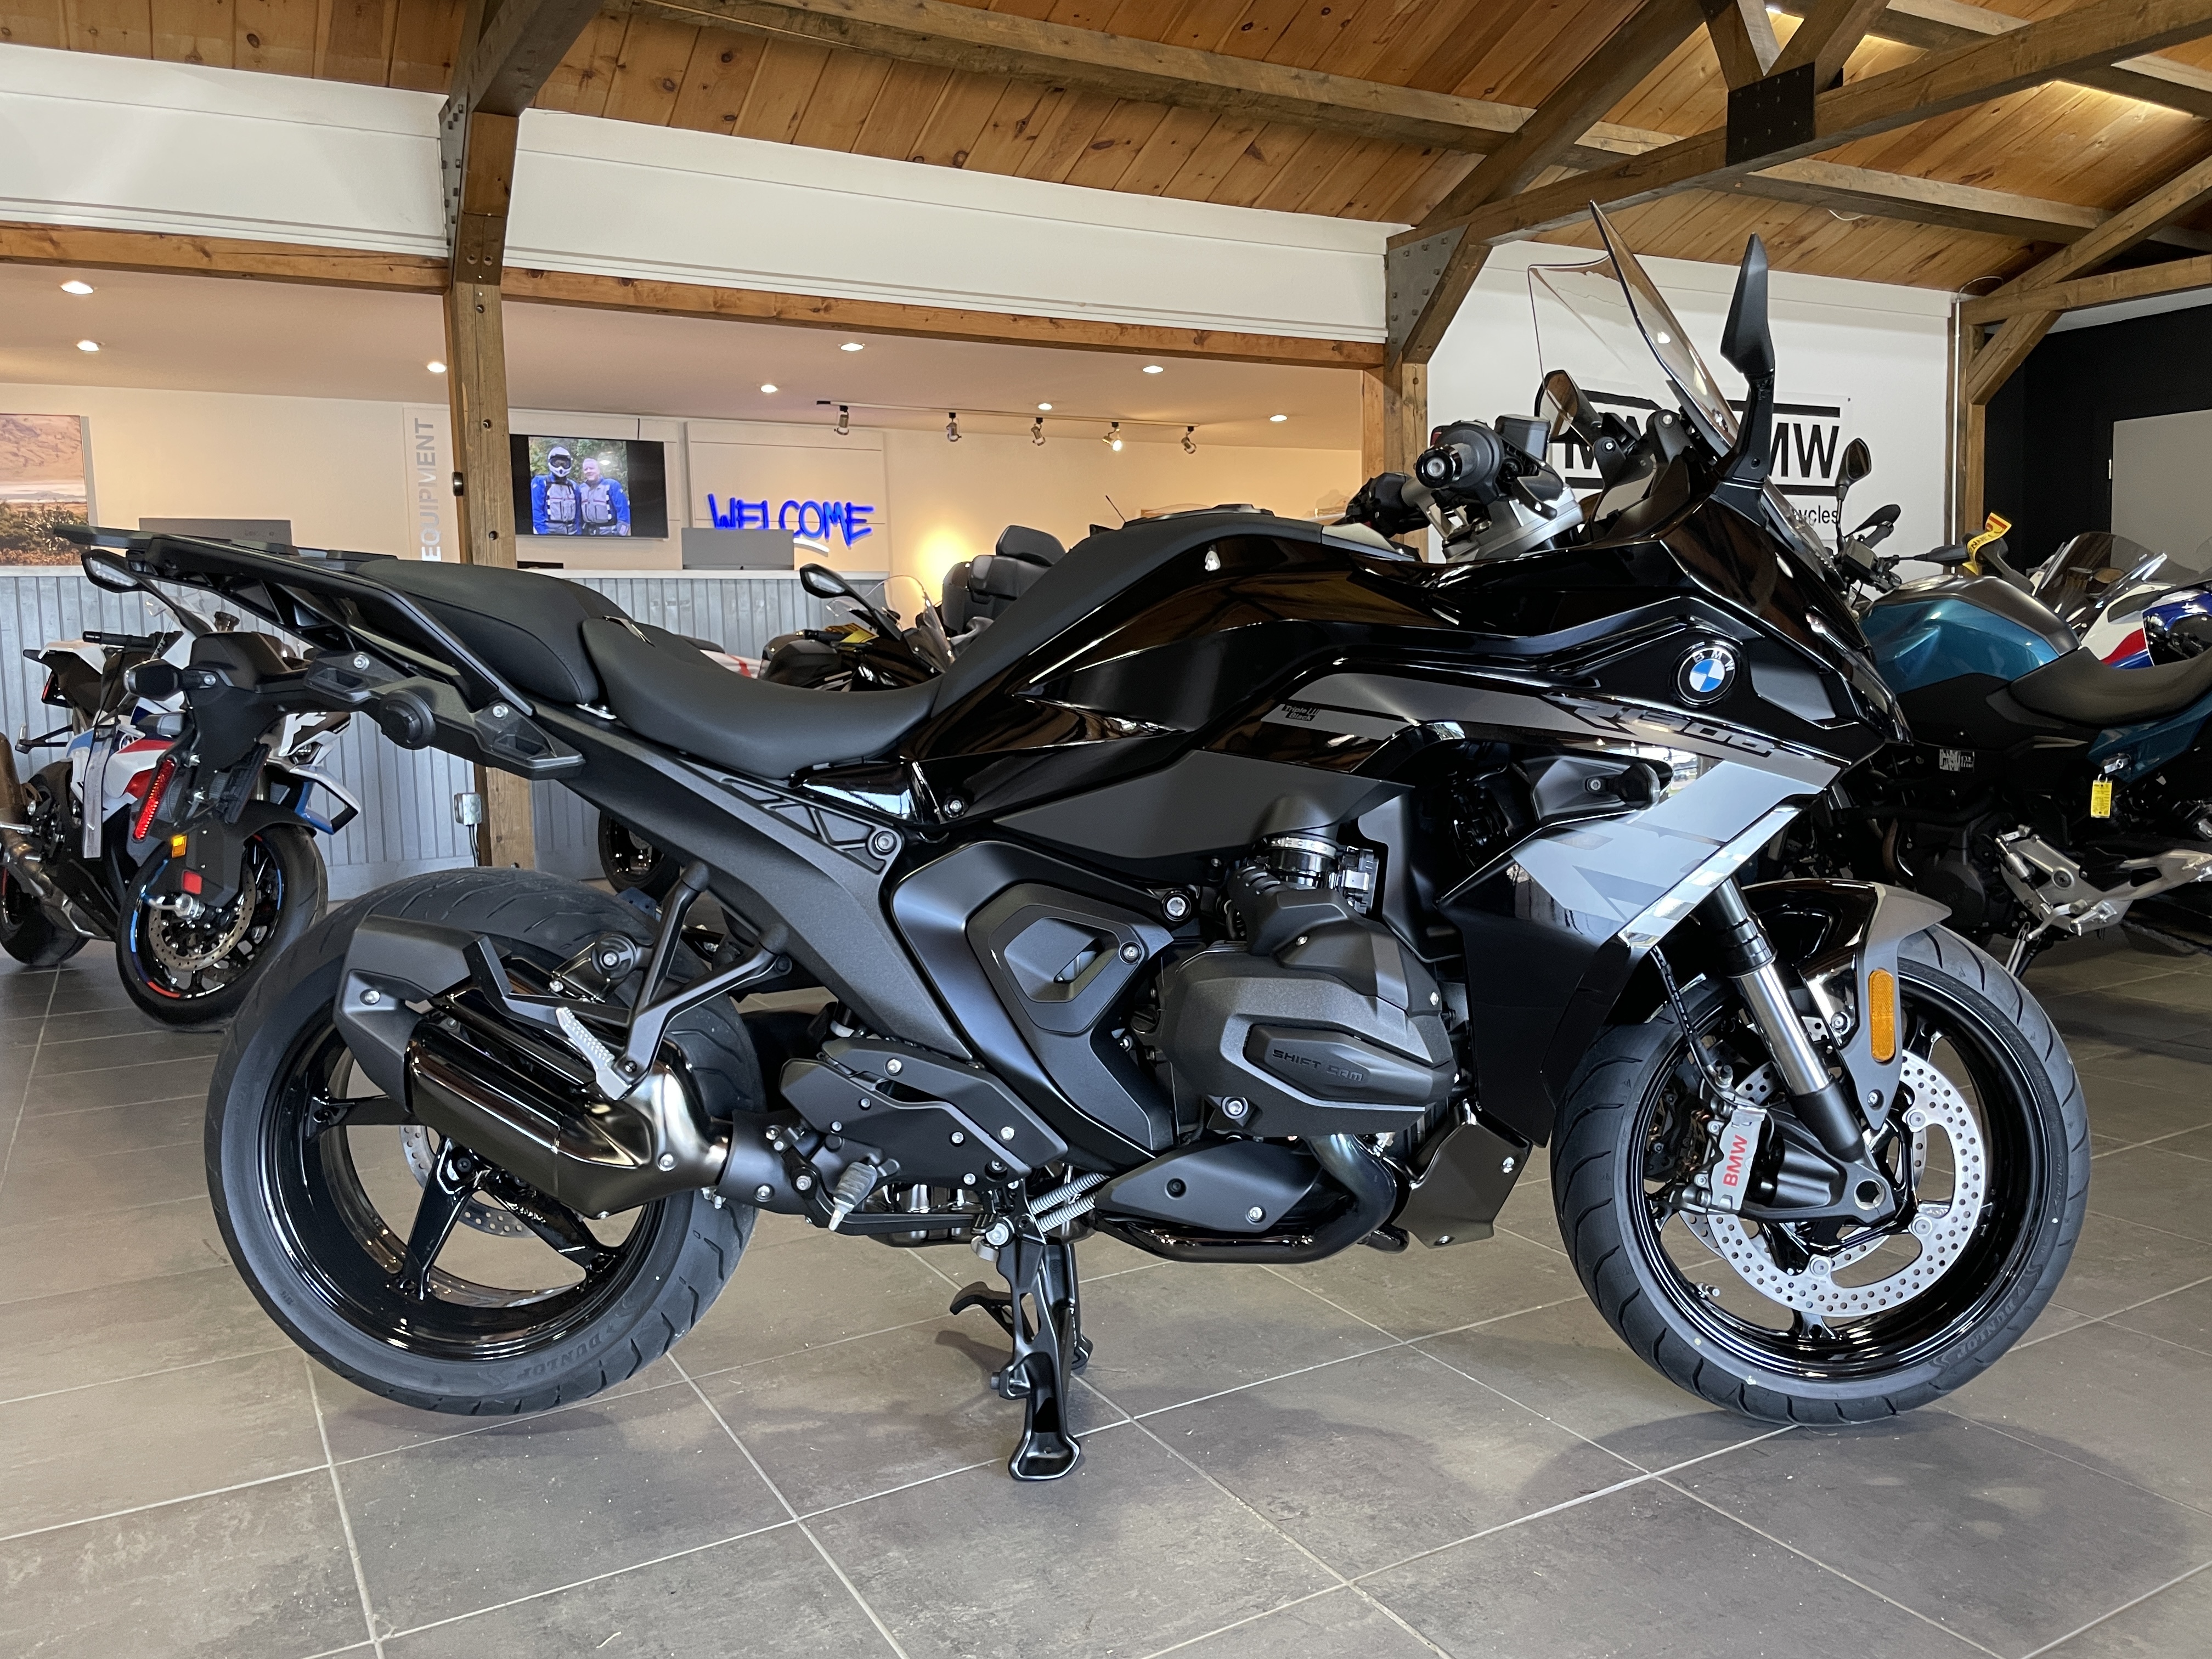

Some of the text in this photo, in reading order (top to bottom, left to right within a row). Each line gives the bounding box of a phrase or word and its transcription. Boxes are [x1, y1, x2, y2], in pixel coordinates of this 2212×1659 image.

[1769, 422, 1839, 478] MW
[415, 418, 441, 561] EQUIPMENT
[708, 493, 875, 547] WELCOME
[1692, 649, 1735, 672] BMW
[1285, 705, 1307, 714] Triple
[1289, 713, 1312, 721] Black
[1272, 1049, 1322, 1069] SHIFT
[1723, 1134, 1747, 1187] BMW
[1957, 1298, 2016, 1359] DUNLOP
[517, 1333, 602, 1380] DUNLOP
